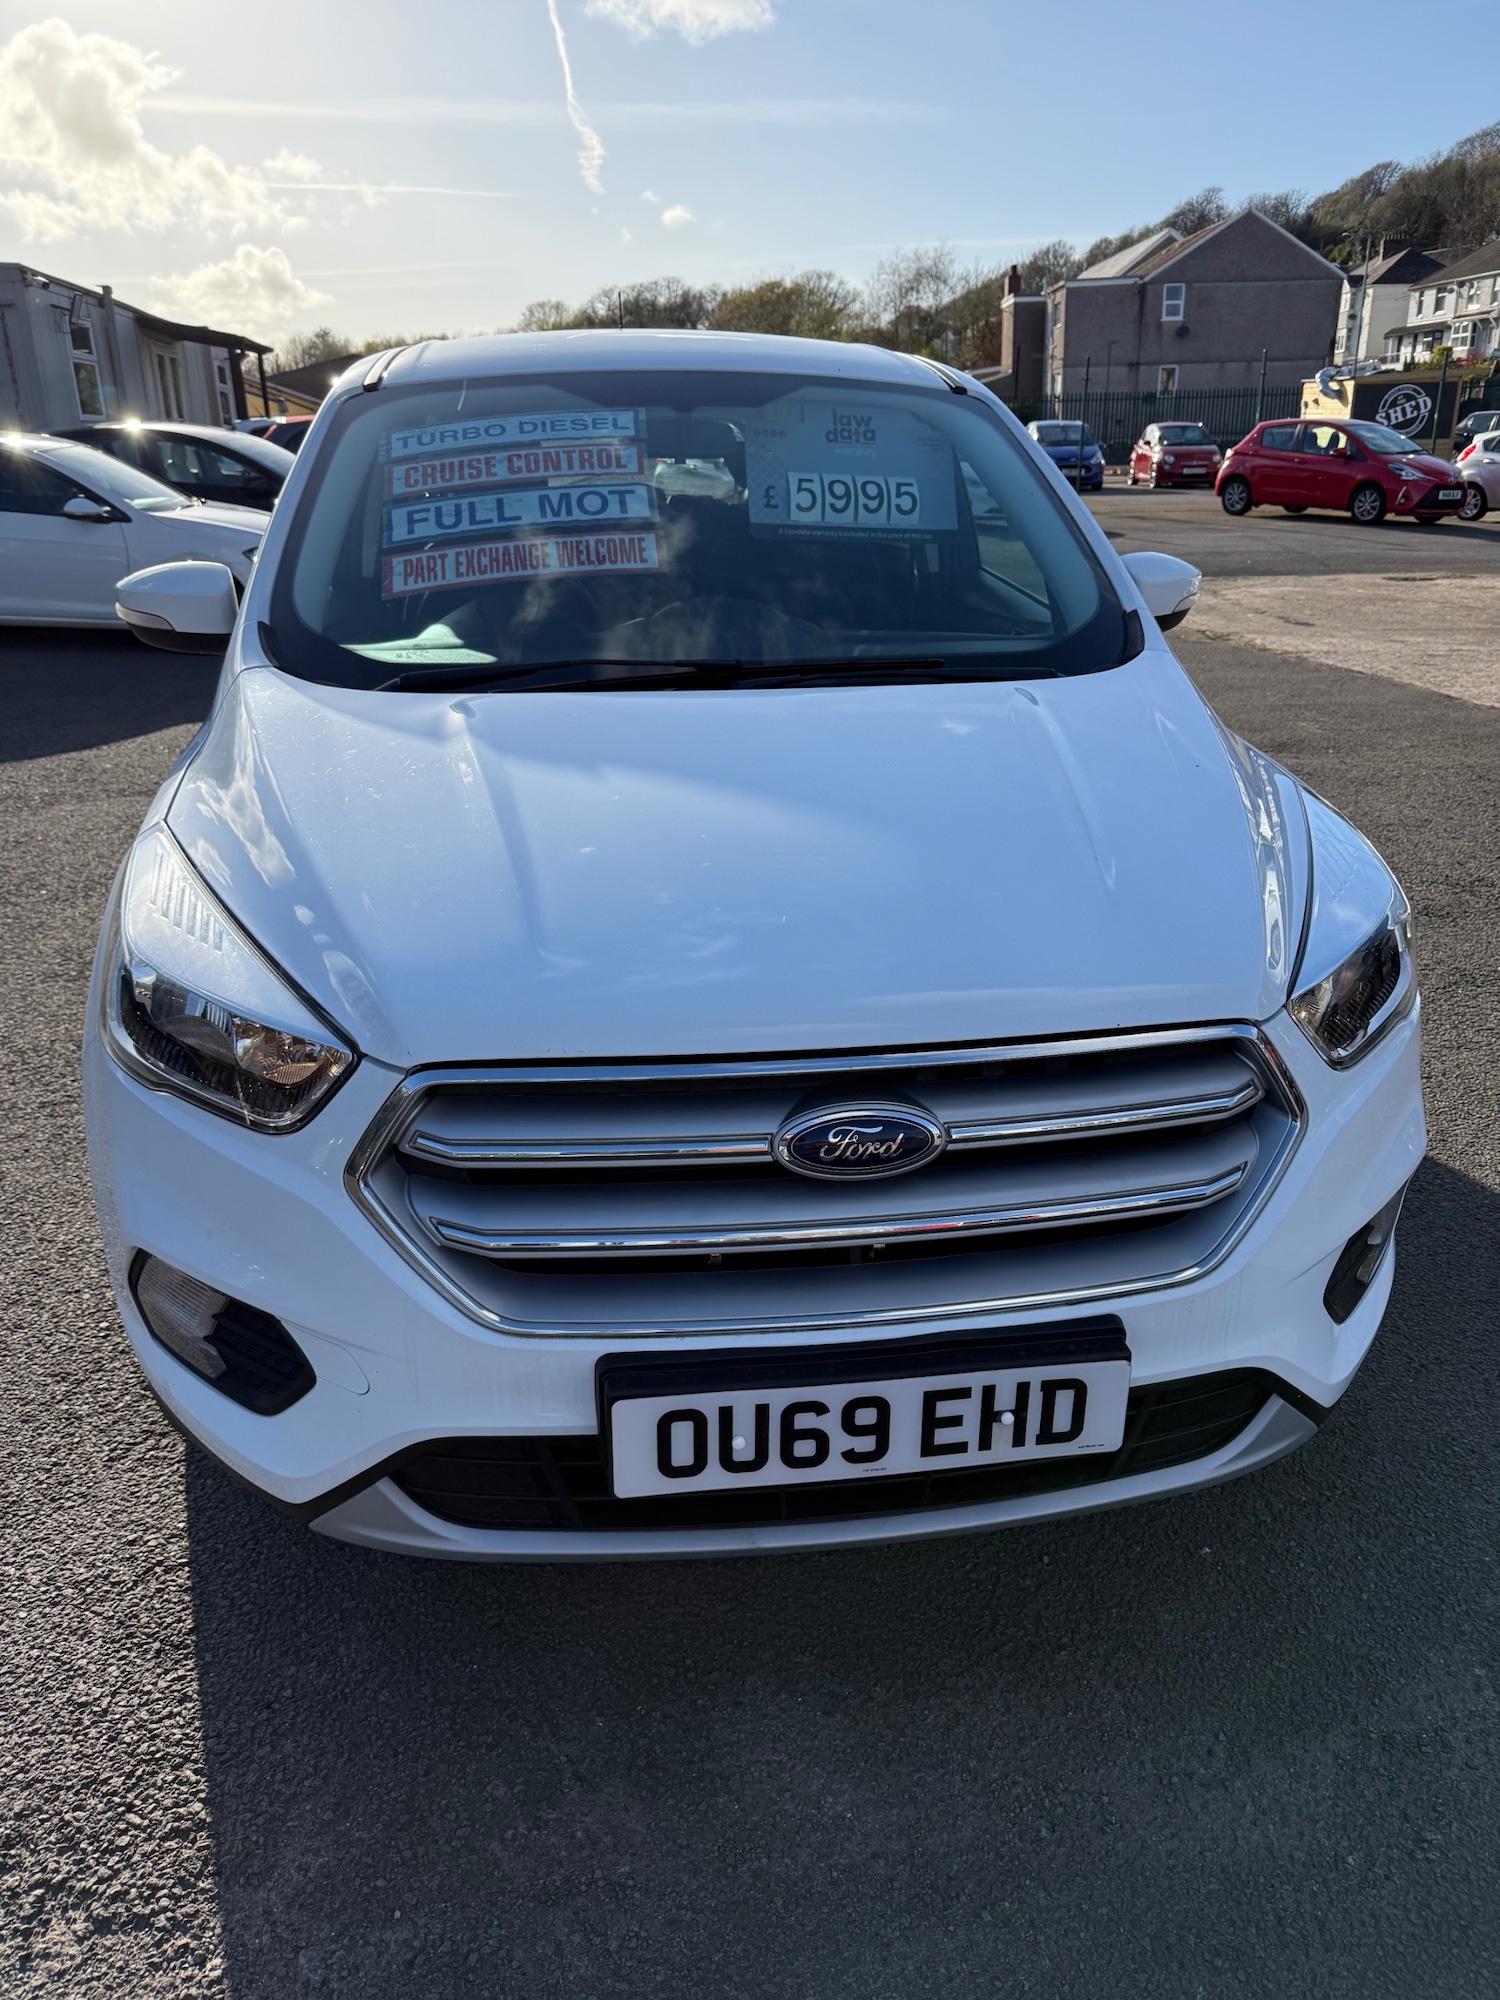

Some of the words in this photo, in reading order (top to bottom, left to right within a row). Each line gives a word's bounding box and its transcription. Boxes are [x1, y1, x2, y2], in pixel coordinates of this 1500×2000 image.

[832, 408, 873, 427] law
[1375, 396, 1433, 426] SHED
[395, 424, 507, 449] TURBO
[518, 416, 630, 434] DIESEL
[825, 427, 876, 444] data
[404, 455, 497, 489] CRUISE
[507, 447, 628, 476] CONTROL
[834, 447, 877, 459] warranty
[406, 497, 522, 536] FULL
[538, 489, 637, 520] MOT
[763, 484, 779, 509] £
[794, 477, 919, 516] 5995
[403, 553, 448, 587] PART
[455, 541, 550, 579] EXCHANGE
[555, 536, 648, 566] WELCOME
[819, 1125, 905, 1161] Ford
[656, 1394, 892, 1479] OU69
[919, 1377, 1089, 1459] EHD
